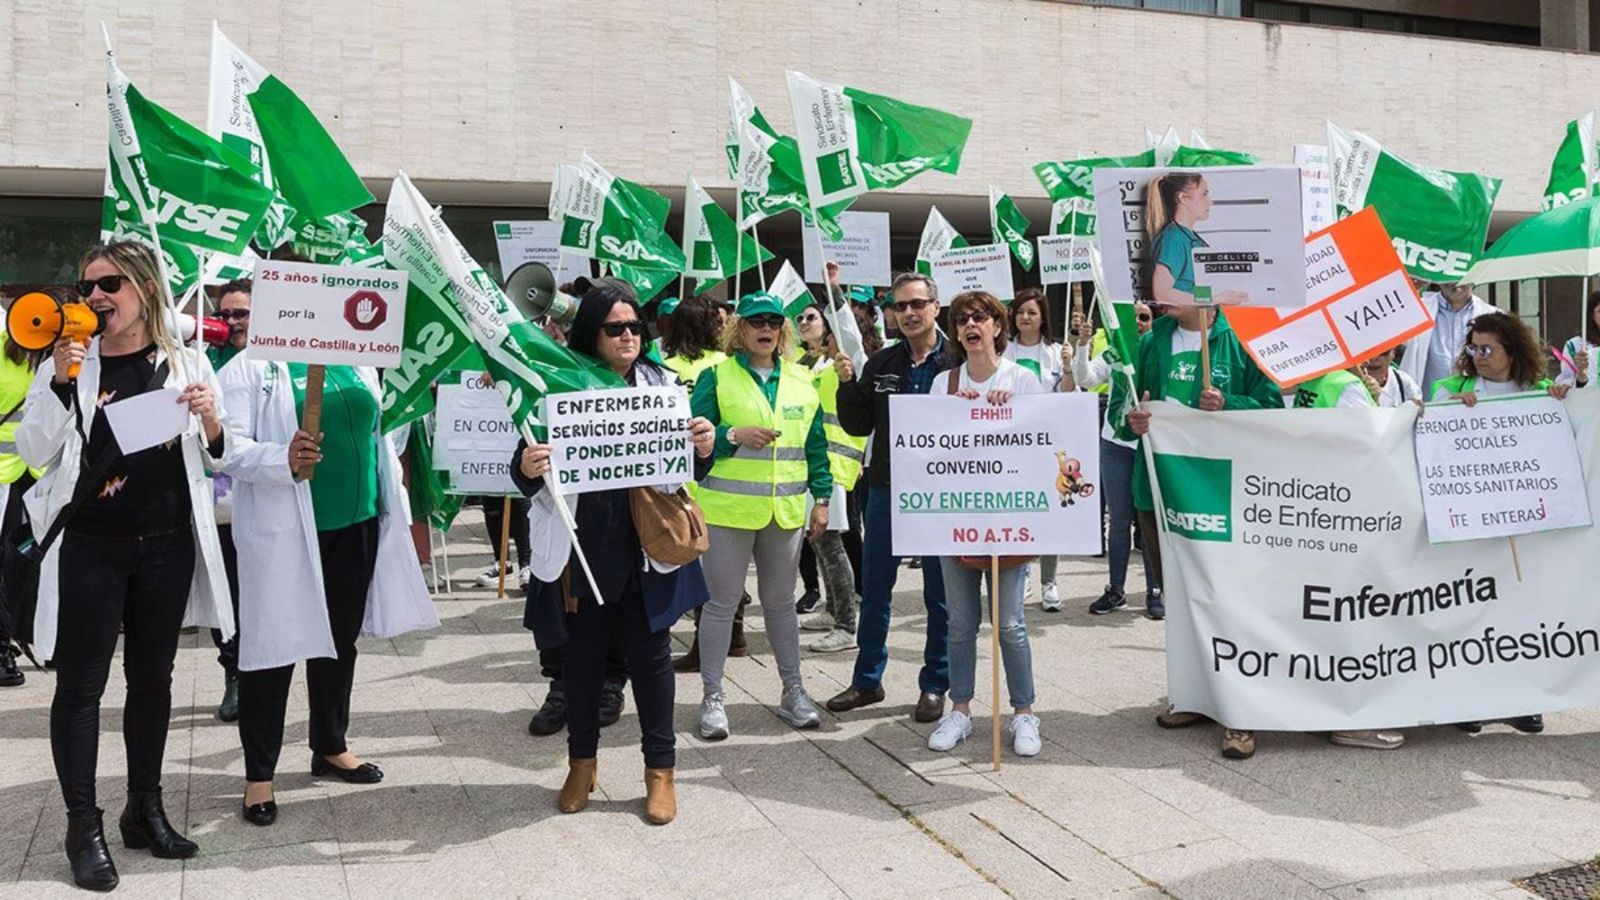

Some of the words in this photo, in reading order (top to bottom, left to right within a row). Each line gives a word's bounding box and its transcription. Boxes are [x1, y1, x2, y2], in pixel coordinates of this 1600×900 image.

[152, 186, 250, 242] TSE
[1055, 248, 1070, 257] NO
[1072, 247, 1090, 257] SON
[1392, 236, 1473, 276] ATSE
[1043, 265, 1058, 273] UN
[1060, 262, 1091, 271] NGO
[262, 270, 279, 281] 25
[284, 271, 318, 284] años
[322, 273, 399, 290] ignorados
[278, 309, 301, 320] por
[304, 309, 316, 320] la
[1344, 290, 1405, 331] YA!!!
[250, 335, 287, 348] Junta
[290, 336, 306, 348] de
[309, 337, 356, 350] Castilla
[359, 342, 367, 354] y
[369, 341, 400, 353] León
[1258, 340, 1290, 360] PARA
[1270, 340, 1339, 374] ENFERMERAS
[557, 395, 676, 415] ENFERMERAS
[970, 407, 1014, 420] EHH!!!
[454, 420, 476, 432] EN
[1470, 417, 1488, 431] DE
[1491, 411, 1562, 430] SERVICIOS
[895, 434, 906, 448] A
[909, 434, 935, 448] LOS
[939, 434, 970, 450] QUE
[973, 433, 1033, 447] FIRMAIS
[1036, 432, 1053, 446] EL
[1454, 434, 1518, 451] SOCIALES
[559, 469, 580, 485] DE
[589, 462, 656, 482] NOCHES
[926, 460, 1003, 475] CONVENIO
[1425, 465, 1444, 479] LAS
[1450, 459, 1541, 478] ENFERMERAS
[1244, 475, 1351, 504] Sindicato
[1428, 482, 1472, 496] SOMOS
[1475, 477, 1558, 494] SANITARIOS
[898, 491, 934, 510] SOY
[940, 490, 1049, 509] ENFERMERA
[1167, 509, 1227, 534] SATSE
[1243, 503, 1272, 524] de
[1278, 505, 1402, 533] Enfermería
[953, 528, 979, 543] NO
[984, 528, 1036, 543] A.T.S.
[1243, 531, 1260, 546] Lo
[1265, 535, 1293, 550] que
[1297, 536, 1325, 551] nos
[1329, 540, 1358, 554] une
[1302, 569, 1498, 623] Enfermería
[1212, 636, 1279, 678] Por
[1288, 644, 1417, 684] nuestra
[1427, 622, 1600, 679] profesión
